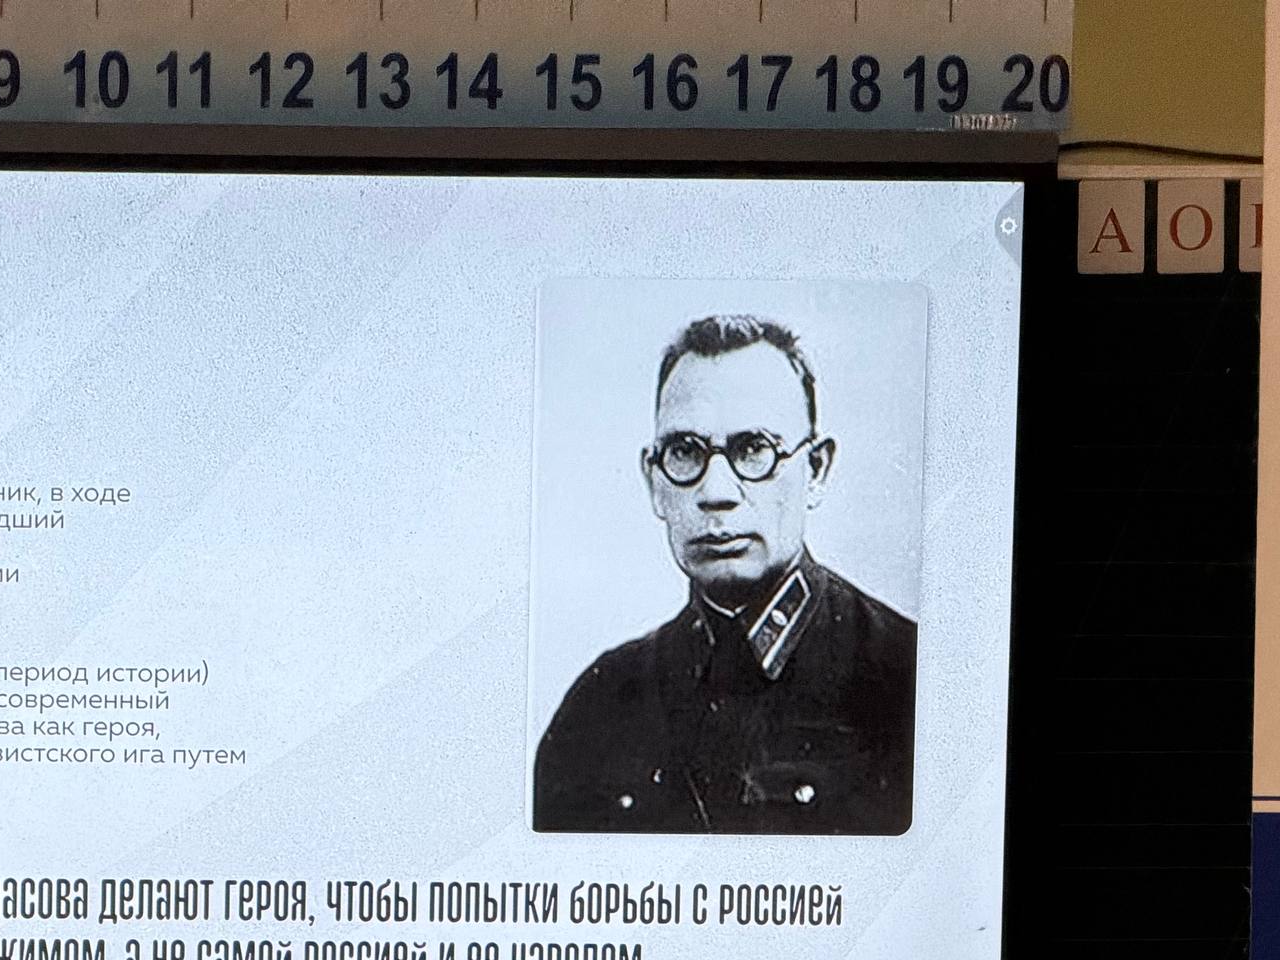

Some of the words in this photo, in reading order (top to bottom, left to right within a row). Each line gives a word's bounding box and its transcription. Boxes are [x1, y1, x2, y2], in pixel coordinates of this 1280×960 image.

[63, 49, 130, 108] 10
[156, 50, 212, 108] 11
[249, 51, 315, 109] 12
[346, 51, 411, 110] 13
[436, 51, 503, 110] 14
[535, 52, 602, 111] 15
[632, 53, 699, 111] 16
[726, 54, 794, 111] 17
[816, 54, 882, 112] 18
[903, 54, 969, 113] 19
[1002, 53, 1070, 113] 20
[1088, 206, 1134, 254] А
[50, 487, 64, 502] в
[71, 487, 131, 504] ходе
[96, 662, 209, 689] истории)
[33, 720, 75, 736] как
[82, 720, 161, 742] героя,
[123, 748, 166, 764] ига
[172, 749, 246, 770] путем
[98, 878, 215, 925] делают
[224, 879, 316, 927] героя,
[326, 878, 418, 923] чтобы
[428, 881, 559, 924] попытки
[569, 879, 681, 925] борьбы
[692, 883, 708, 926] с
